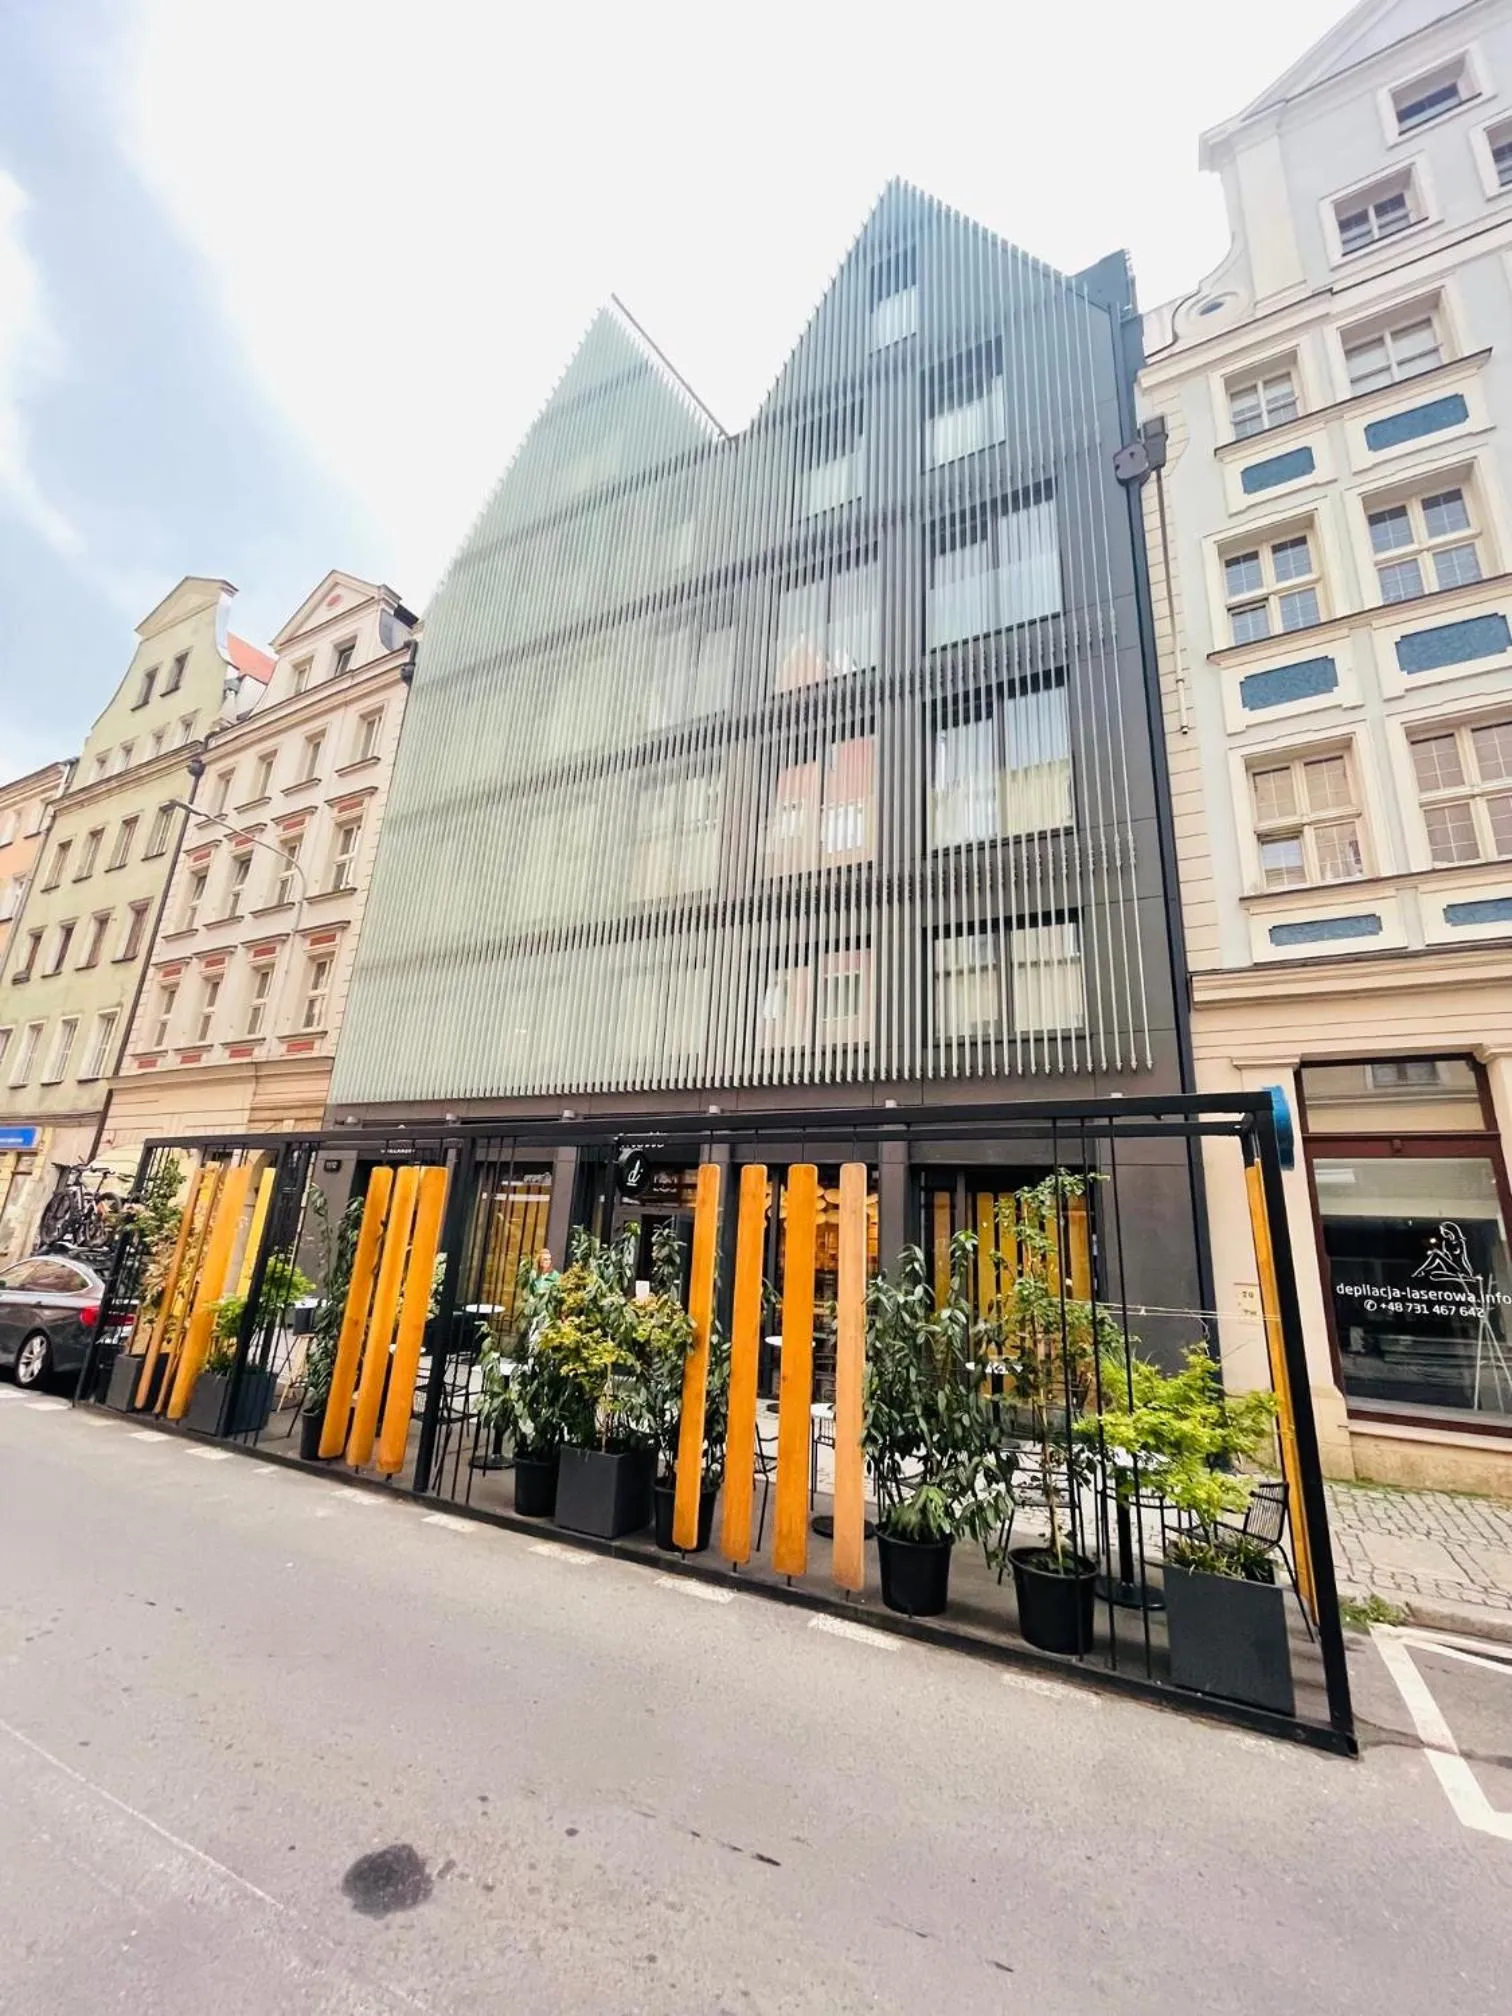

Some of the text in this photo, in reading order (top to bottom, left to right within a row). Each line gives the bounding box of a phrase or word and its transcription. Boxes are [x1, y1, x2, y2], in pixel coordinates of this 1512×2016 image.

[1380, 1302, 1403, 1313] +48
[1406, 1302, 1429, 1314] 731
[1432, 1304, 1456, 1316] 467
